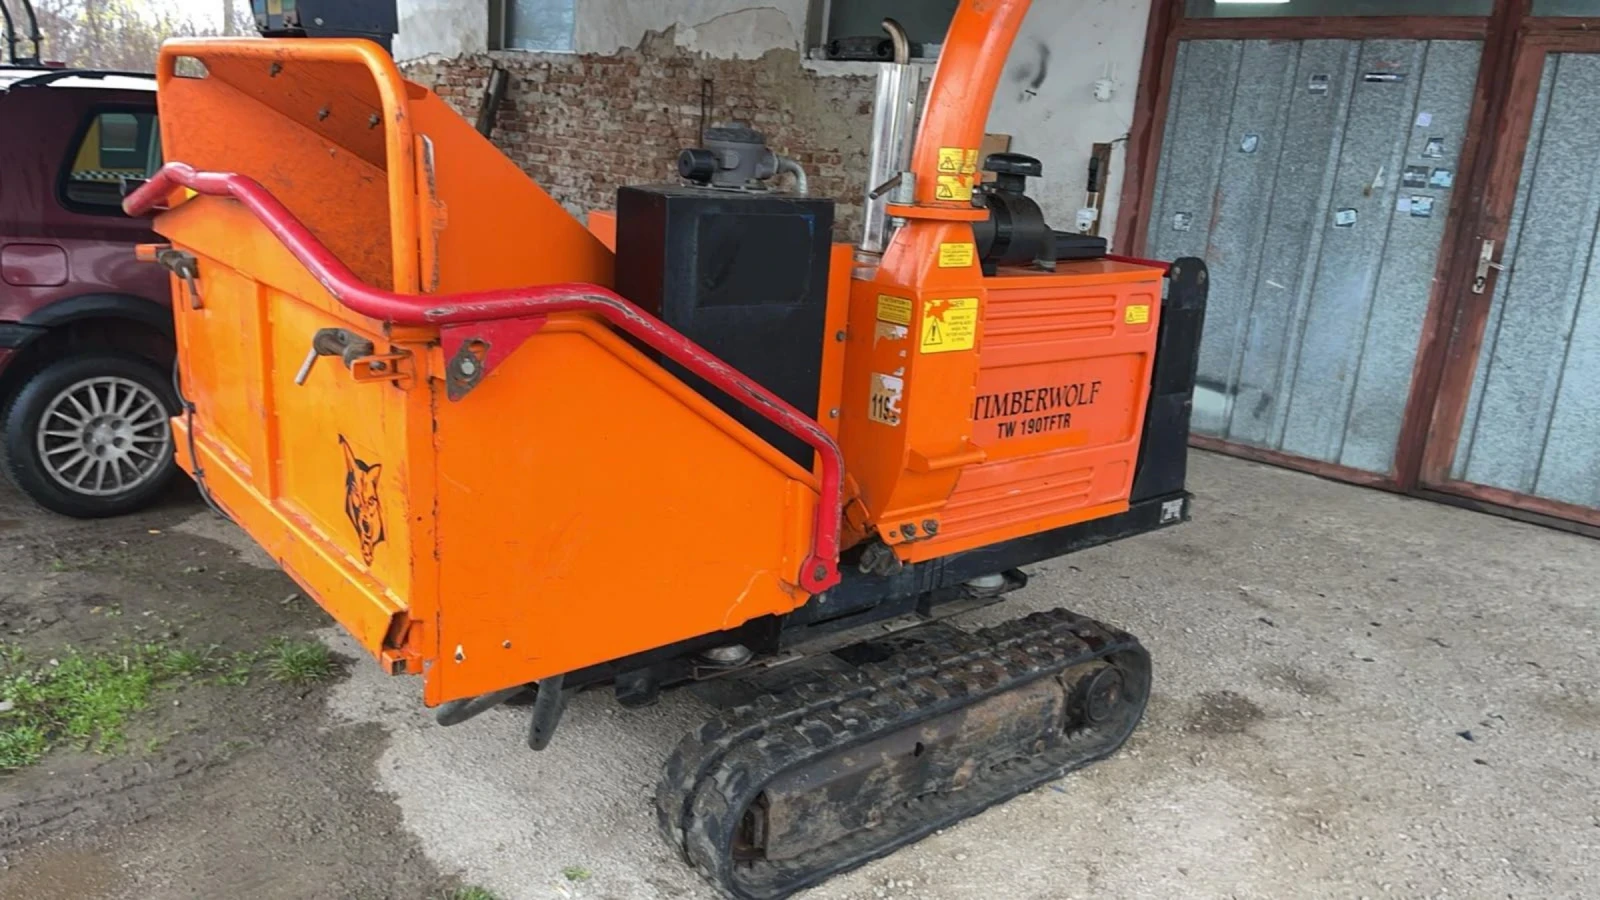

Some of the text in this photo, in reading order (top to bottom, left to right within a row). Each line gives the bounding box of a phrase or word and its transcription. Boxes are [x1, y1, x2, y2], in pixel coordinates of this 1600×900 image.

[974, 381, 1102, 421] TIMBERWOLF
[997, 413, 1072, 439] TW 190TFTR
